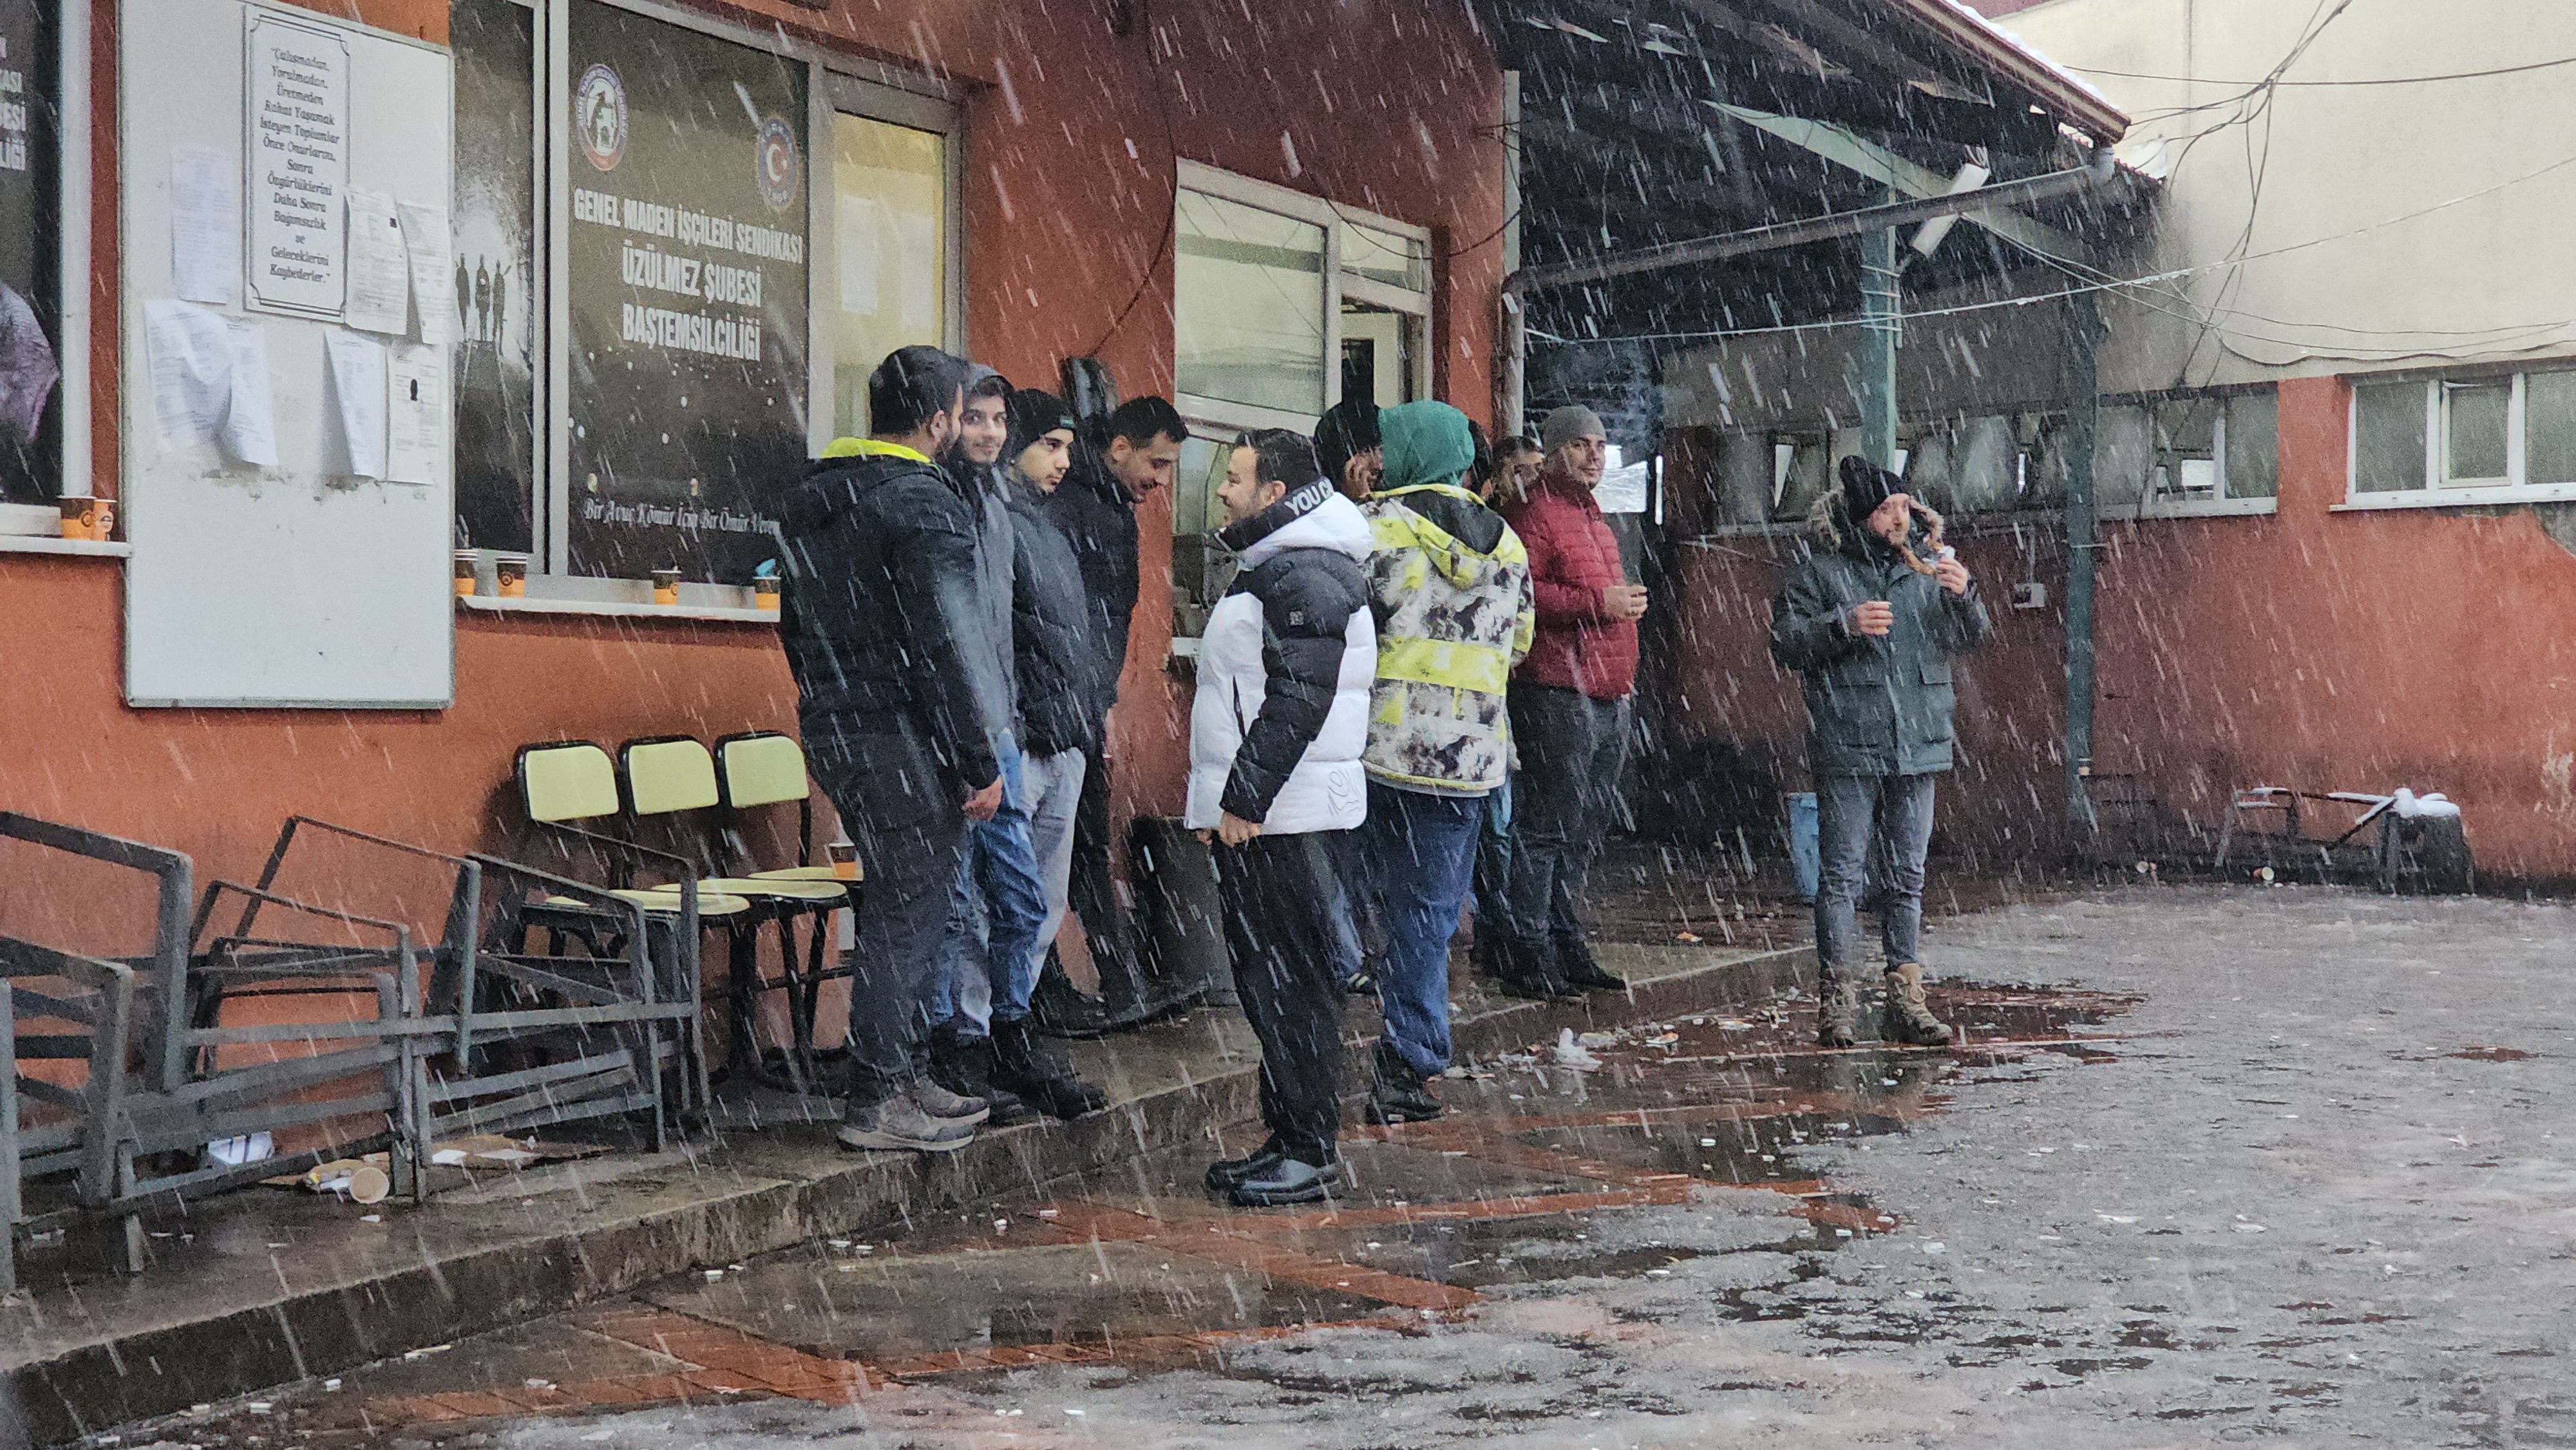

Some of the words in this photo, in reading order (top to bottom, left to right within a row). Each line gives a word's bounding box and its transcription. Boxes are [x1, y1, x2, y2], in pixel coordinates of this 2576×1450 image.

[0, 69, 22, 93] ASI
[277, 82, 323, 105] Üretmeden
[0, 101, 26, 131] ESİ
[264, 100, 292, 116] Rahat
[295, 106, 335, 125] Yaşamak
[260, 115, 291, 135] İsteyen
[294, 124, 340, 144] Toplumlar
[263, 133, 285, 150] Önce
[287, 159, 314, 174] Sonra
[268, 171, 332, 196] Özgürlüklerini
[274, 193, 298, 207] Daha
[300, 198, 327, 212] Sonra
[274, 211, 327, 230] Bağımsızlık
[574, 188, 620, 227] GENEL
[624, 198, 674, 238] MADEN
[677, 203, 733, 250] İŞÇİLERİ
[737, 223, 802, 264] SENDİKASI
[295, 235, 305, 244] ve
[271, 246, 328, 265] Geleceklerini
[623, 239, 701, 296] ÜZÜLMEZ
[704, 265, 761, 308] ŞUBESİ
[623, 302, 761, 361] BAŞTEMSİLCİLİĞİ
[1284, 485, 1321, 517] YOU
[584, 498, 604, 520] Bir
[603, 500, 635, 528] Avuç
[637, 502, 675, 528] Kömür
[719, 507, 750, 532] Ömür
